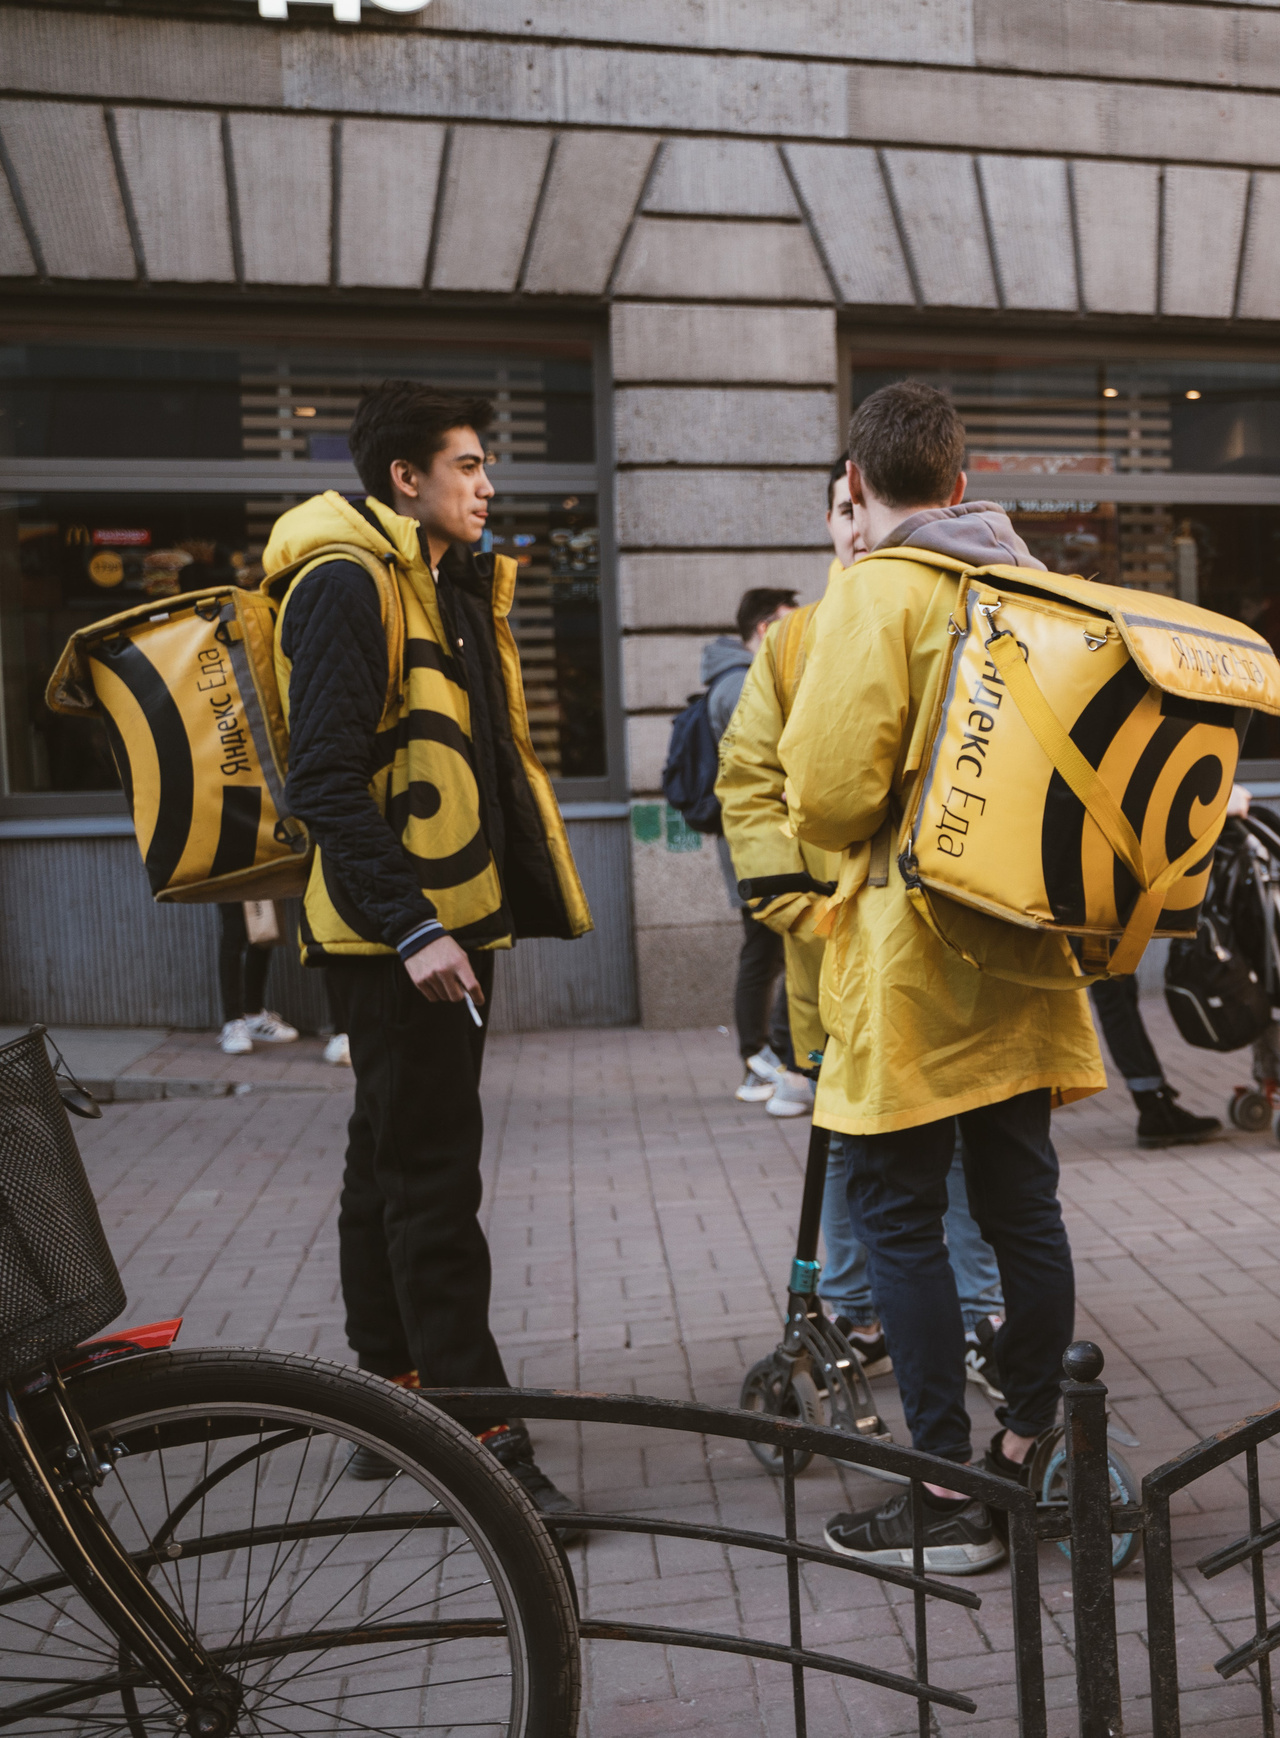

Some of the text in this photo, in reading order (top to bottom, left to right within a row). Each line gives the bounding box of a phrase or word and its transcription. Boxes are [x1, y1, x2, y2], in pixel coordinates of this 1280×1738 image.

[197, 647, 252, 776] Яндекс Еда
[935, 641, 1029, 858] ндекс Еда
